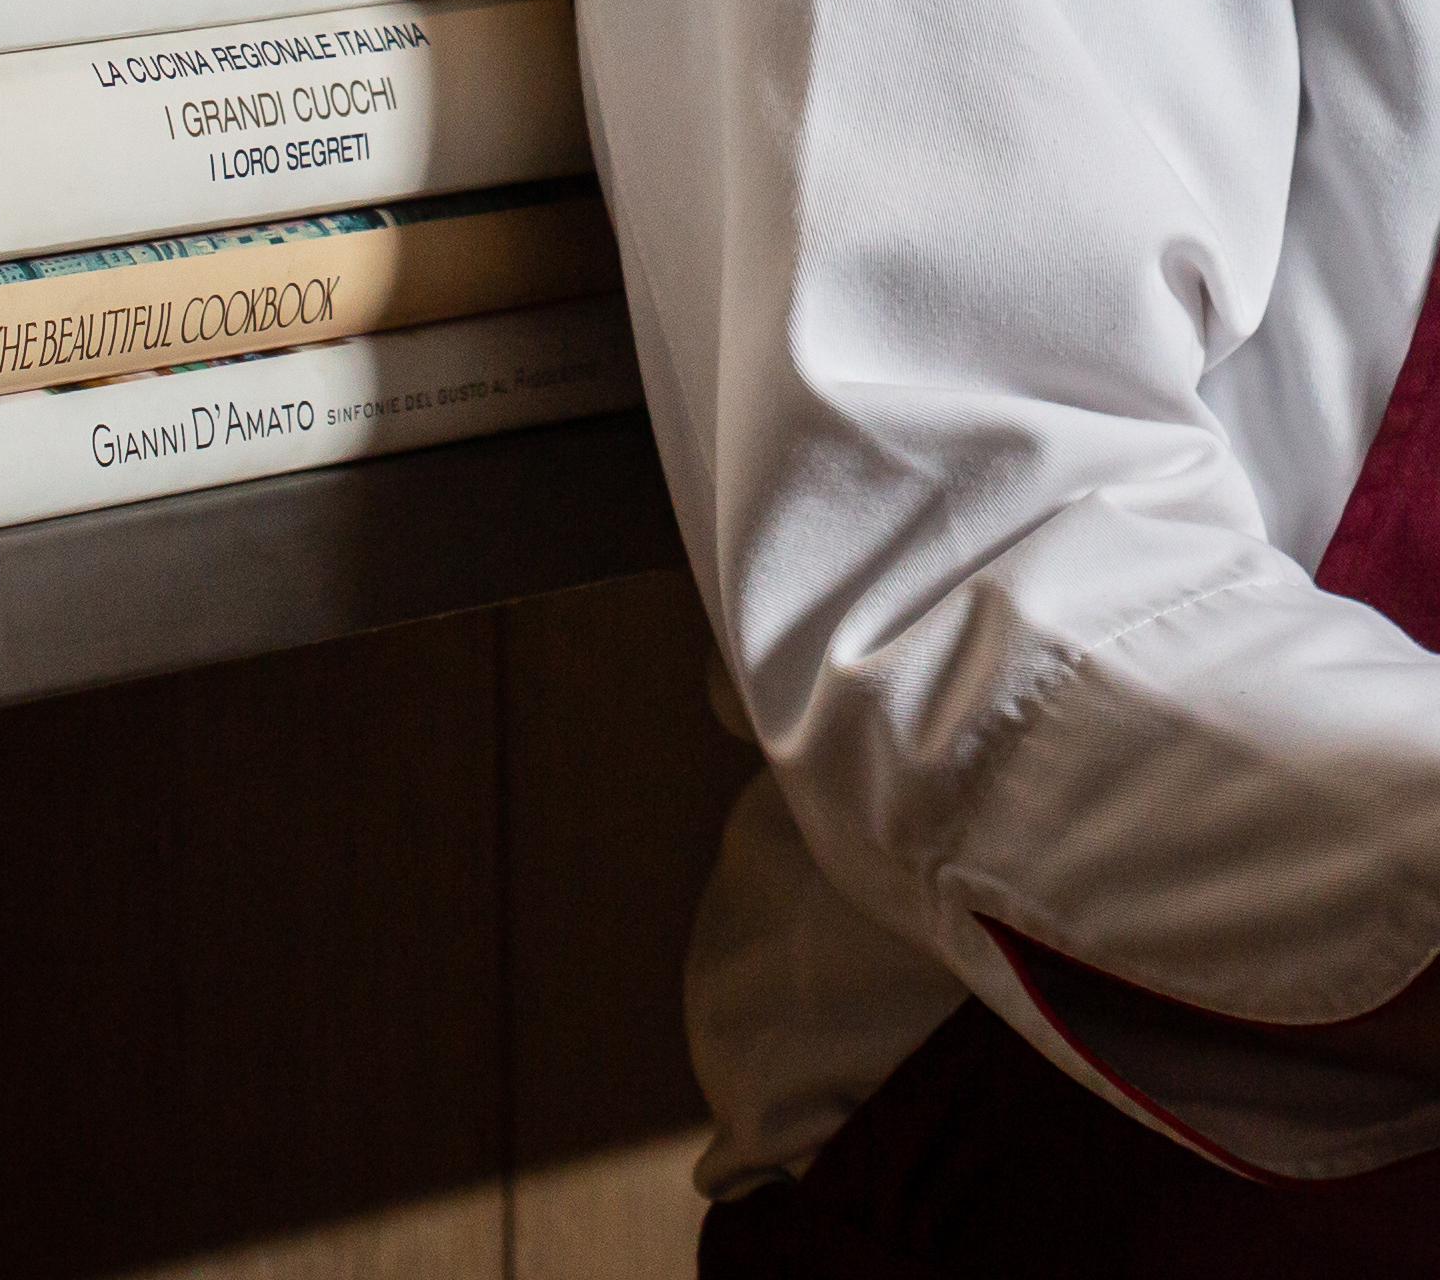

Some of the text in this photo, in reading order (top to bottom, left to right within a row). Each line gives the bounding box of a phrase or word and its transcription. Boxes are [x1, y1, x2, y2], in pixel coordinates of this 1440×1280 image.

[91, 21, 431, 88] LA CUCINA REGIONALE ITALIANA
[164, 75, 398, 140] I GRANDI CUOCHI
[209, 132, 371, 181] I LORO SEGRETI
[38, 301, 174, 367] BEAUTIFUL
[179, 274, 342, 344] COOKBOOK
[91, 391, 435, 468] GIANNI D'AMATO SINFONIE DEL
